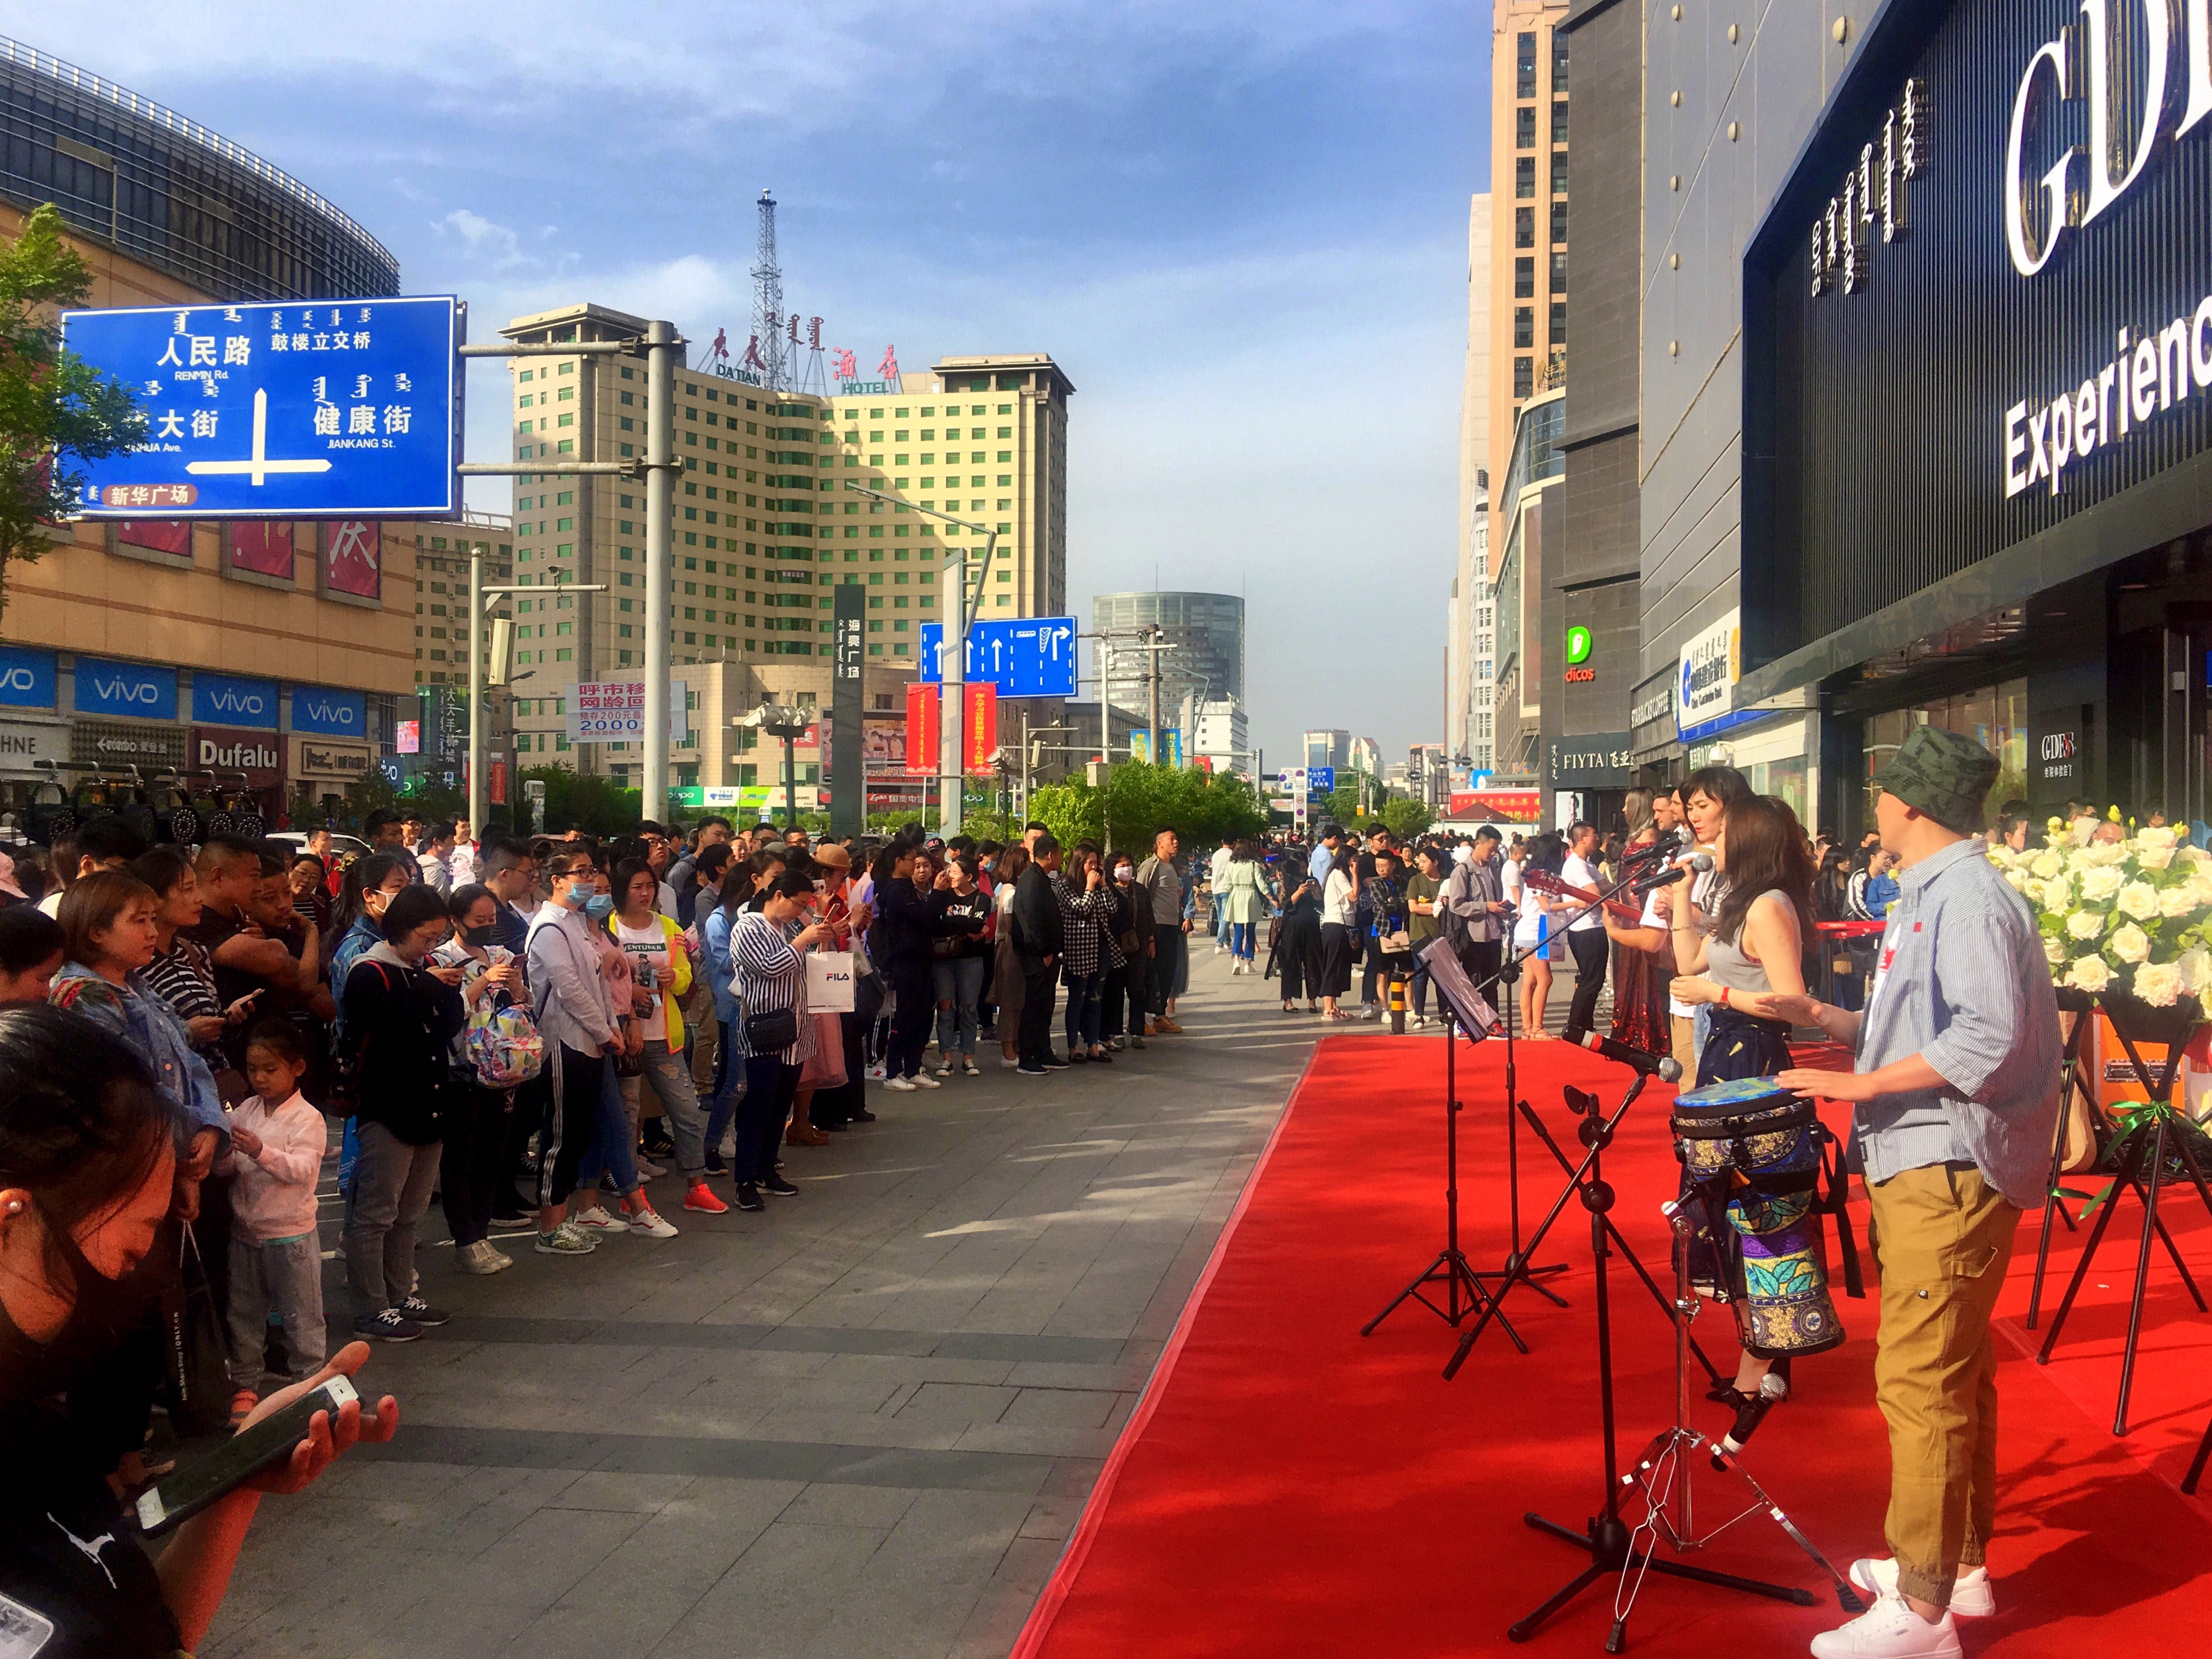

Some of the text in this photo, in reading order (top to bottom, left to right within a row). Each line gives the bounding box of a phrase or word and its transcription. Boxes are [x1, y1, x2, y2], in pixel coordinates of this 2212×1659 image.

[271, 331, 371, 351] 鼓楼立交桥
[156, 335, 251, 367] 人民路
[175, 371, 212, 381] RENMIN
[842, 381, 890, 394] HOTEL
[314, 404, 412, 435] 健康街
[163, 443, 182, 452] Ave.
[327, 438, 396, 449] JIANKANG St.
[111, 485, 189, 505] 新华广场
[847, 619, 860, 679] 海亮广场
[1565, 667, 1594, 682] dicos
[94, 675, 159, 703] vivo
[579, 683, 645, 695] 呼市移
[210, 688, 263, 714] vivo
[580, 696, 645, 708] 网龄回
[308, 699, 353, 724] vivo
[580, 711, 643, 720] 预存200元最
[580, 719, 640, 730] 2000
[200, 740, 277, 768] Dufalu
[1563, 753, 1604, 769] FIYTA
[826, 972, 850, 982] FILA
